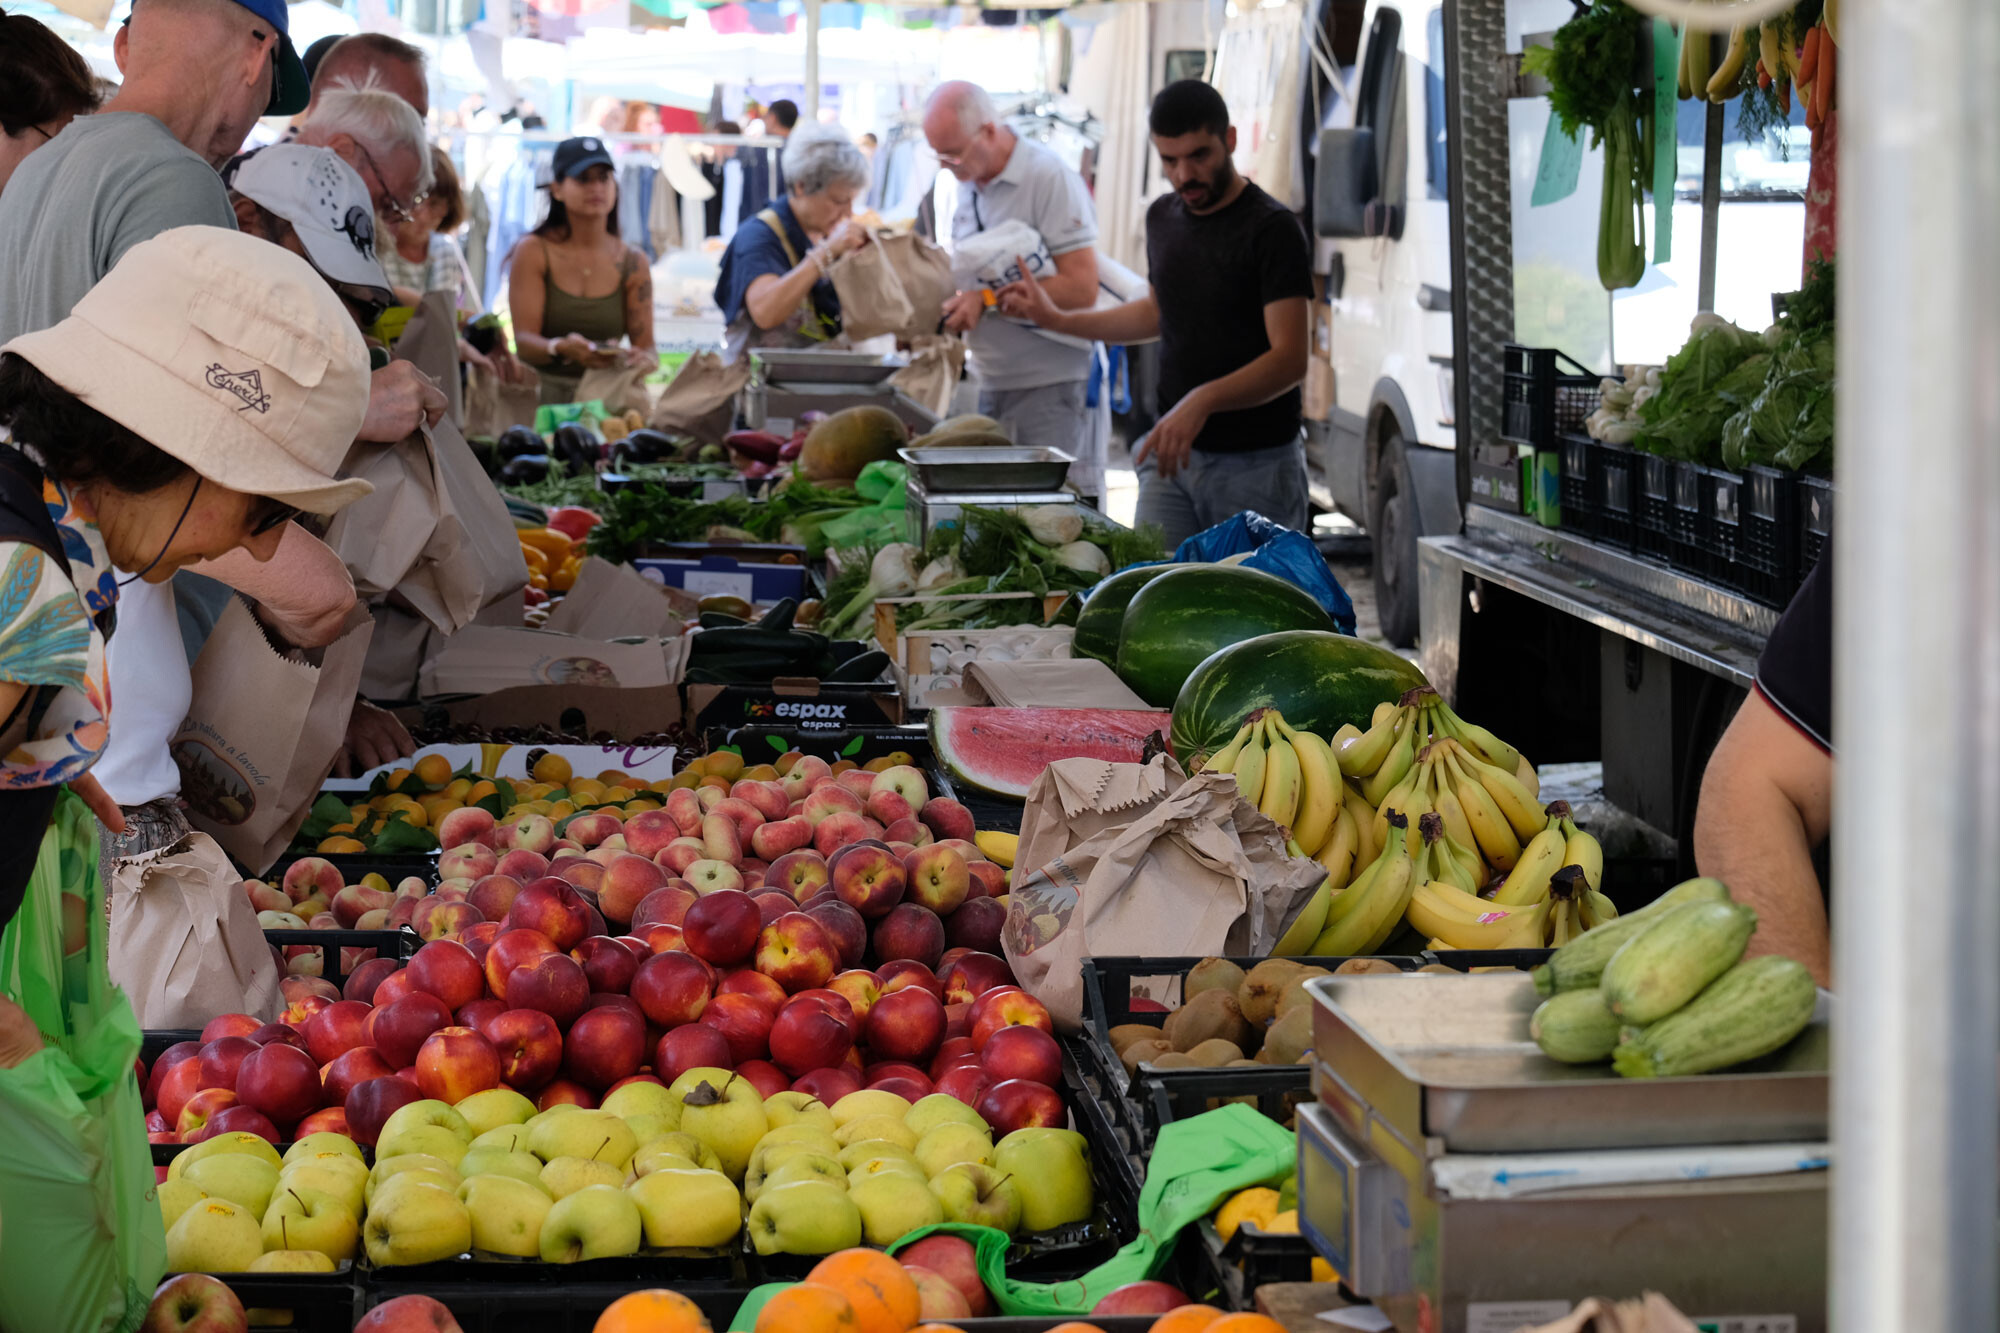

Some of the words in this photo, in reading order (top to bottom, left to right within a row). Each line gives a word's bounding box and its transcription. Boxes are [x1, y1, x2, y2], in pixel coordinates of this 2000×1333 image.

[206, 362, 271, 413] Tenerife
[775, 702, 847, 718] espax
[802, 720, 841, 730] espax
[183, 716, 197, 733] La
[199, 722, 227, 748] natura
[226, 746, 236, 755] a
[236, 752, 271, 786] tavola
